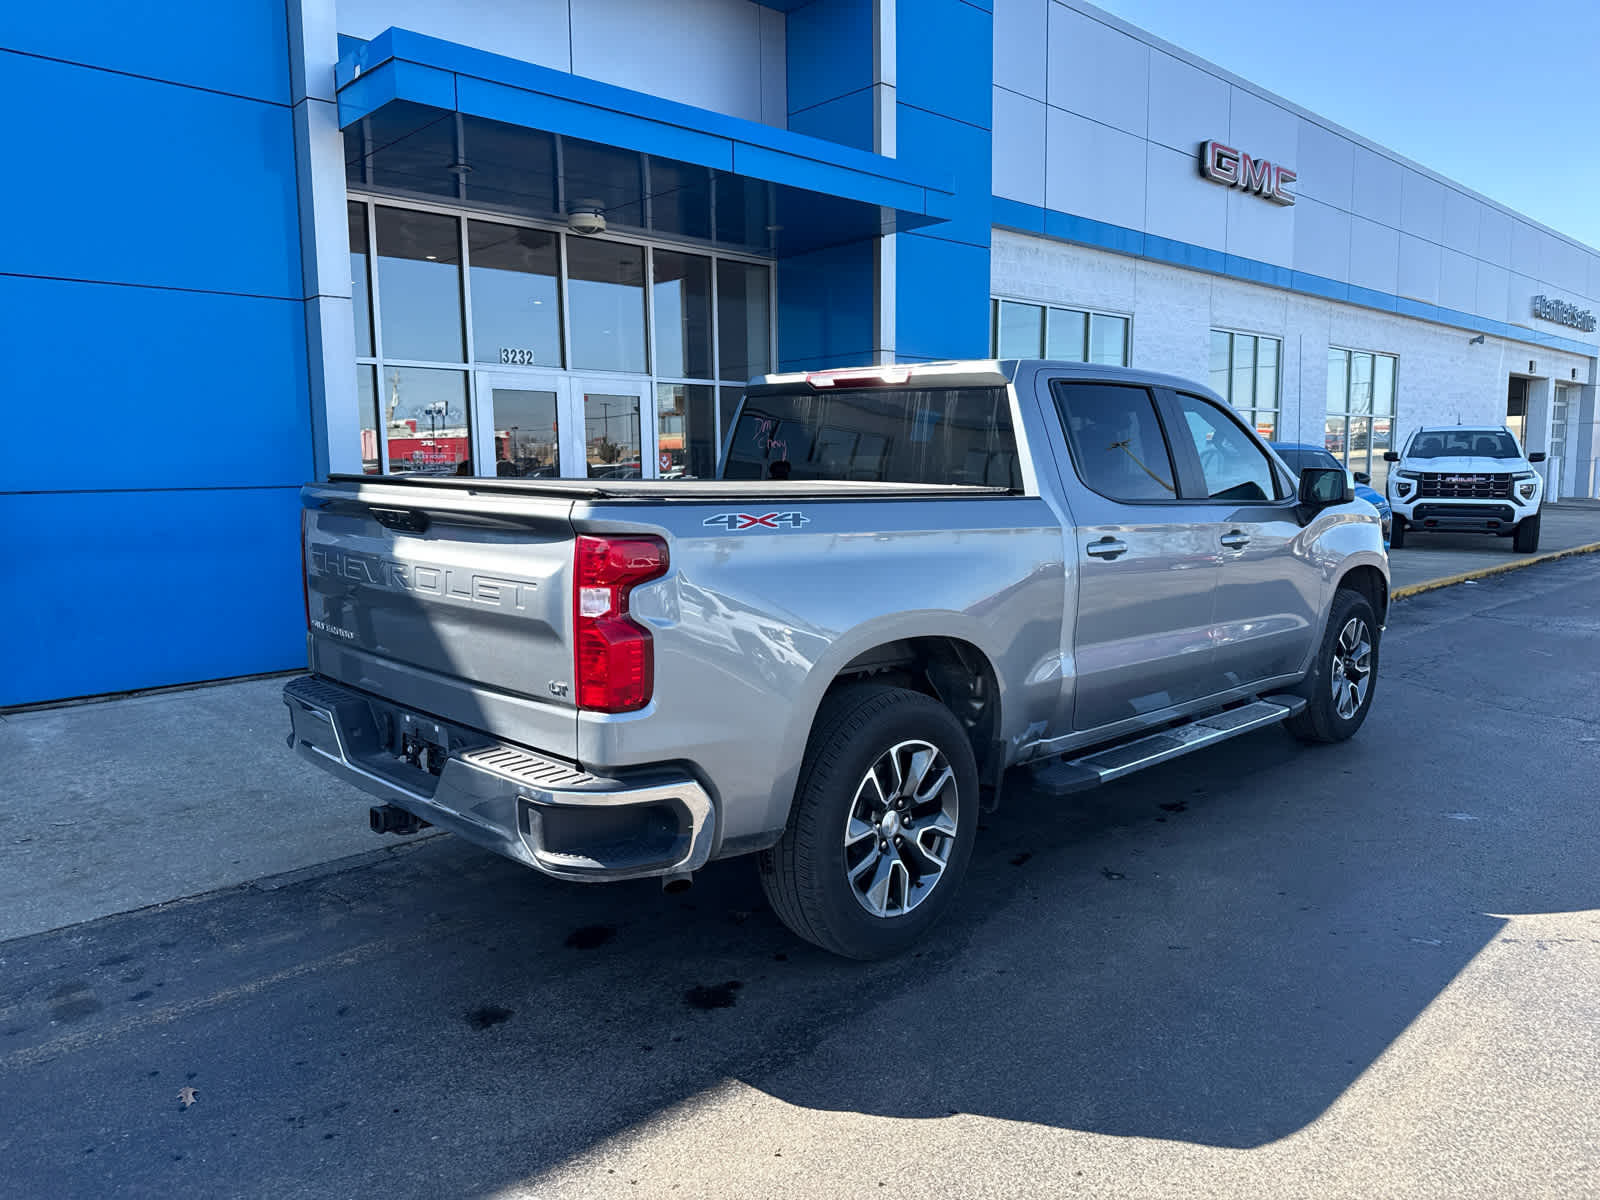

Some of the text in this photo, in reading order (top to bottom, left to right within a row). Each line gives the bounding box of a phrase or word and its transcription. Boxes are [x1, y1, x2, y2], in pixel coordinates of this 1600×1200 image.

[1200, 140, 1297, 206] GMC
[502, 348, 533, 365] 3232
[310, 550, 538, 611] CHEVROLET
[548, 680, 569, 698] LT
